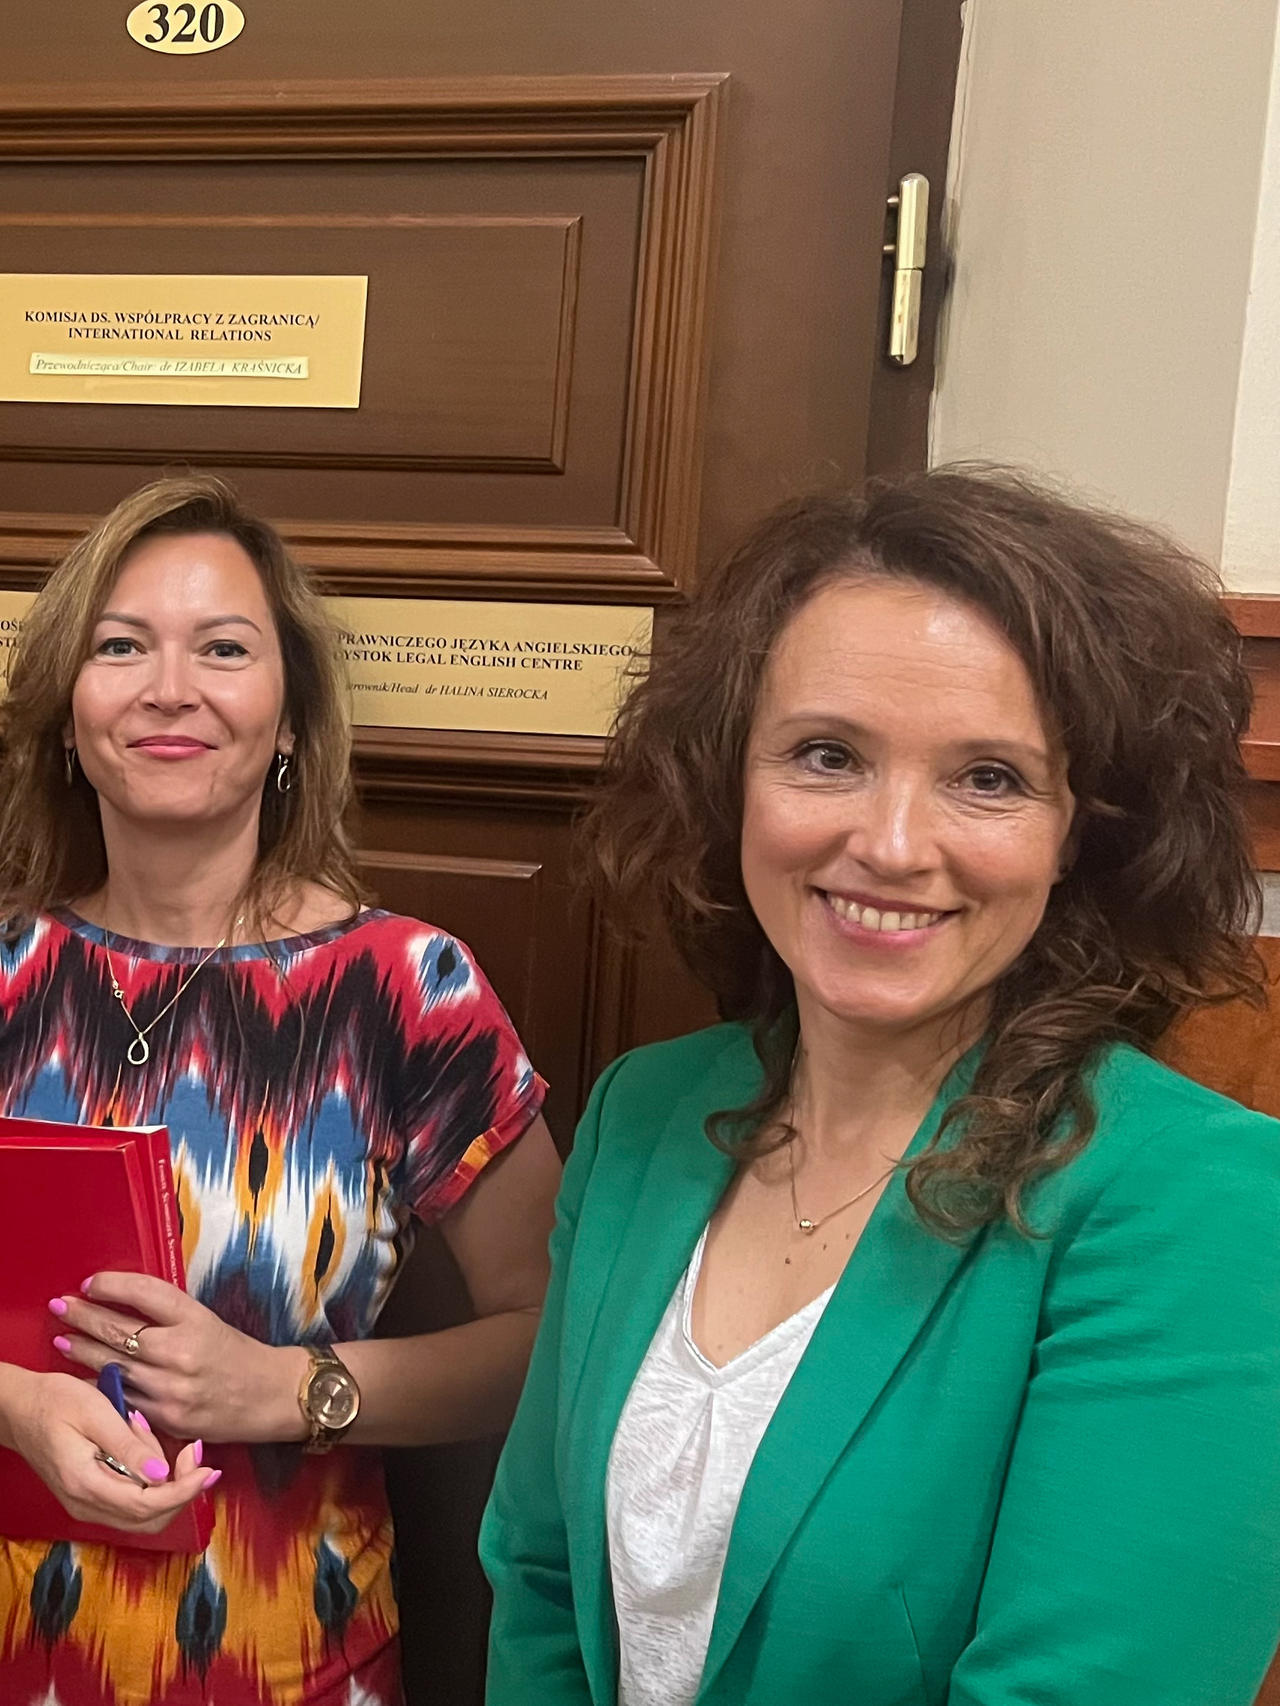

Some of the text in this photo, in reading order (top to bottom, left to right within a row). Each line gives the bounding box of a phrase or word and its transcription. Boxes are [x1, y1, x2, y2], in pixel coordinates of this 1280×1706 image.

[145, 3, 224, 43] 320
[25, 311, 87, 323] KOMISJA
[91, 312, 111, 323] DS.
[216, 314, 225, 325] Z
[69, 327, 272, 341] INTERNATIONAL RELATIONS
[160, 361, 173, 372] dr
[174, 361, 225, 373] IZABELA
[232, 360, 302, 375] KRAŚNICKA
[338, 633, 447, 649] PRAWNICZEGO
[450, 638, 510, 653] JĘZYKA
[397, 652, 446, 665] LEGAL
[450, 654, 516, 668] ENGLISH
[521, 657, 583, 671] CENTRE
[425, 684, 437, 695] dr
[439, 685, 483, 697] HALINA
[487, 687, 548, 700] SIEROCKA
